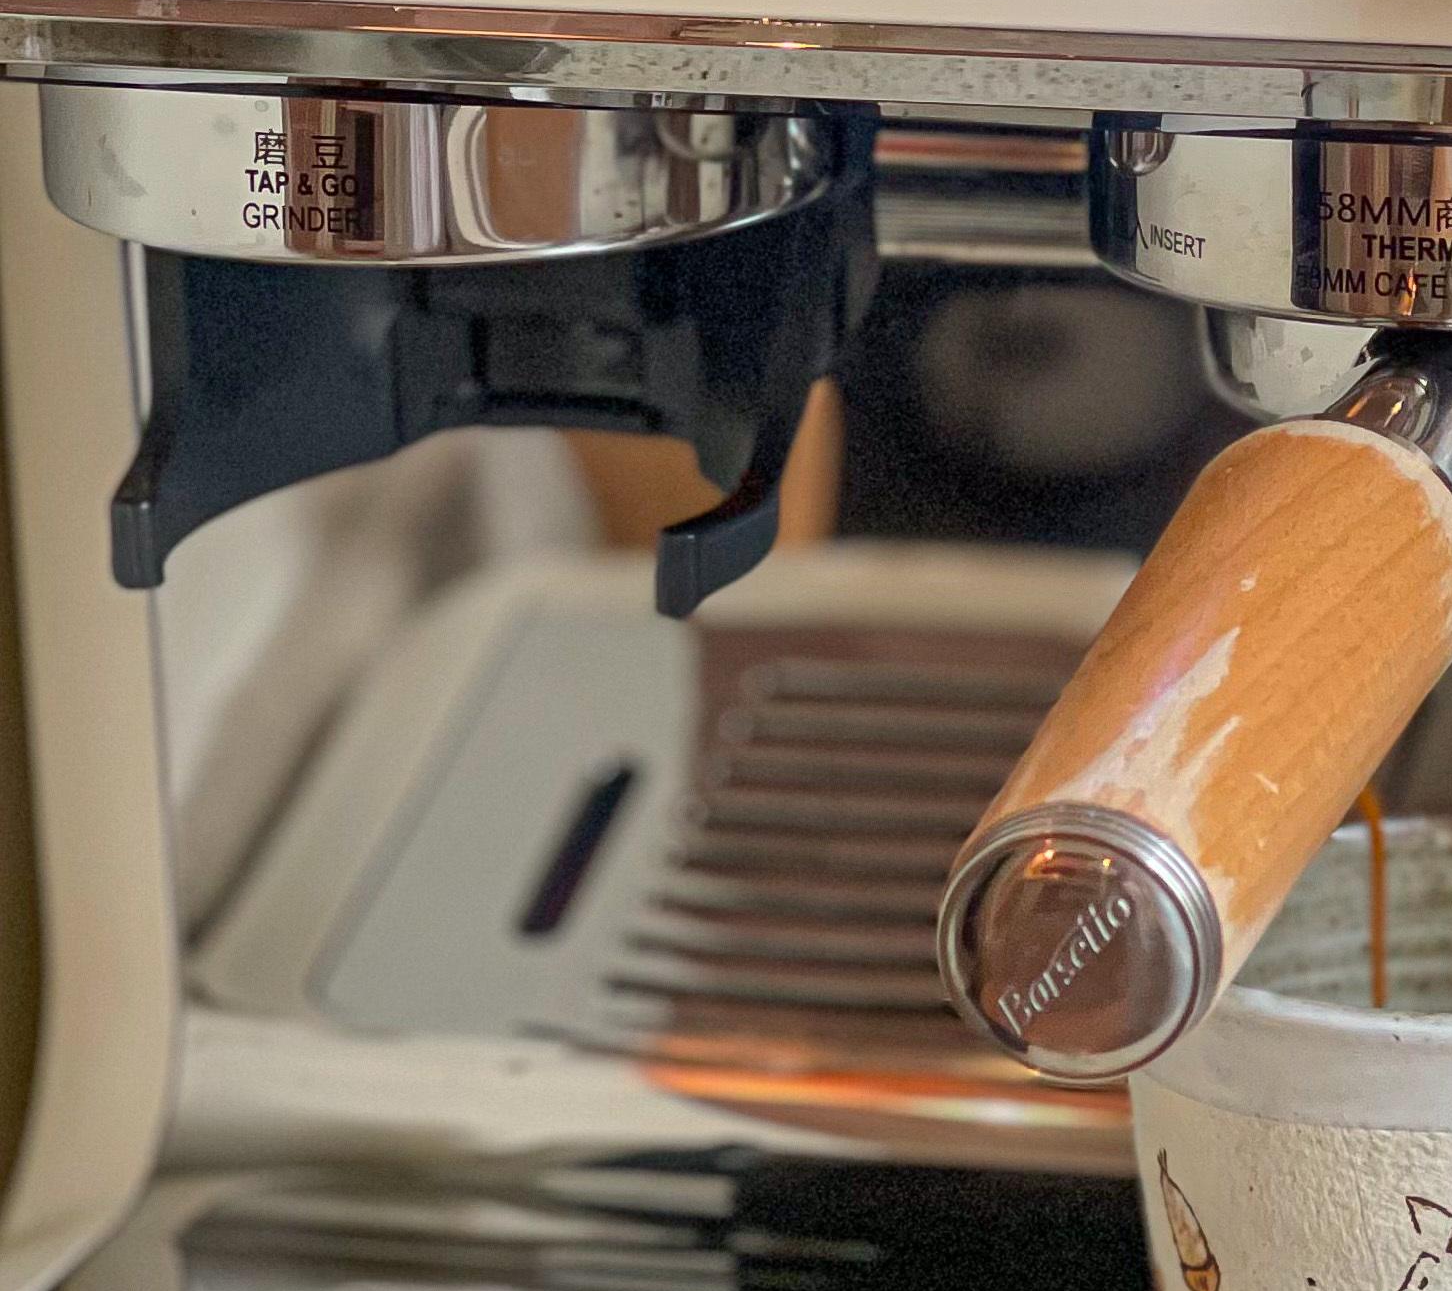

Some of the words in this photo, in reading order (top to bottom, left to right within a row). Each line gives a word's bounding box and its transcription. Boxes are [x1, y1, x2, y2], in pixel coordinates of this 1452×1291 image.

[244, 168, 290, 194] TAP
[296, 172, 314, 196] &
[320, 173, 359, 197] GO
[242, 202, 362, 235] GRINDER
[1149, 223, 1206, 259] INSERT
